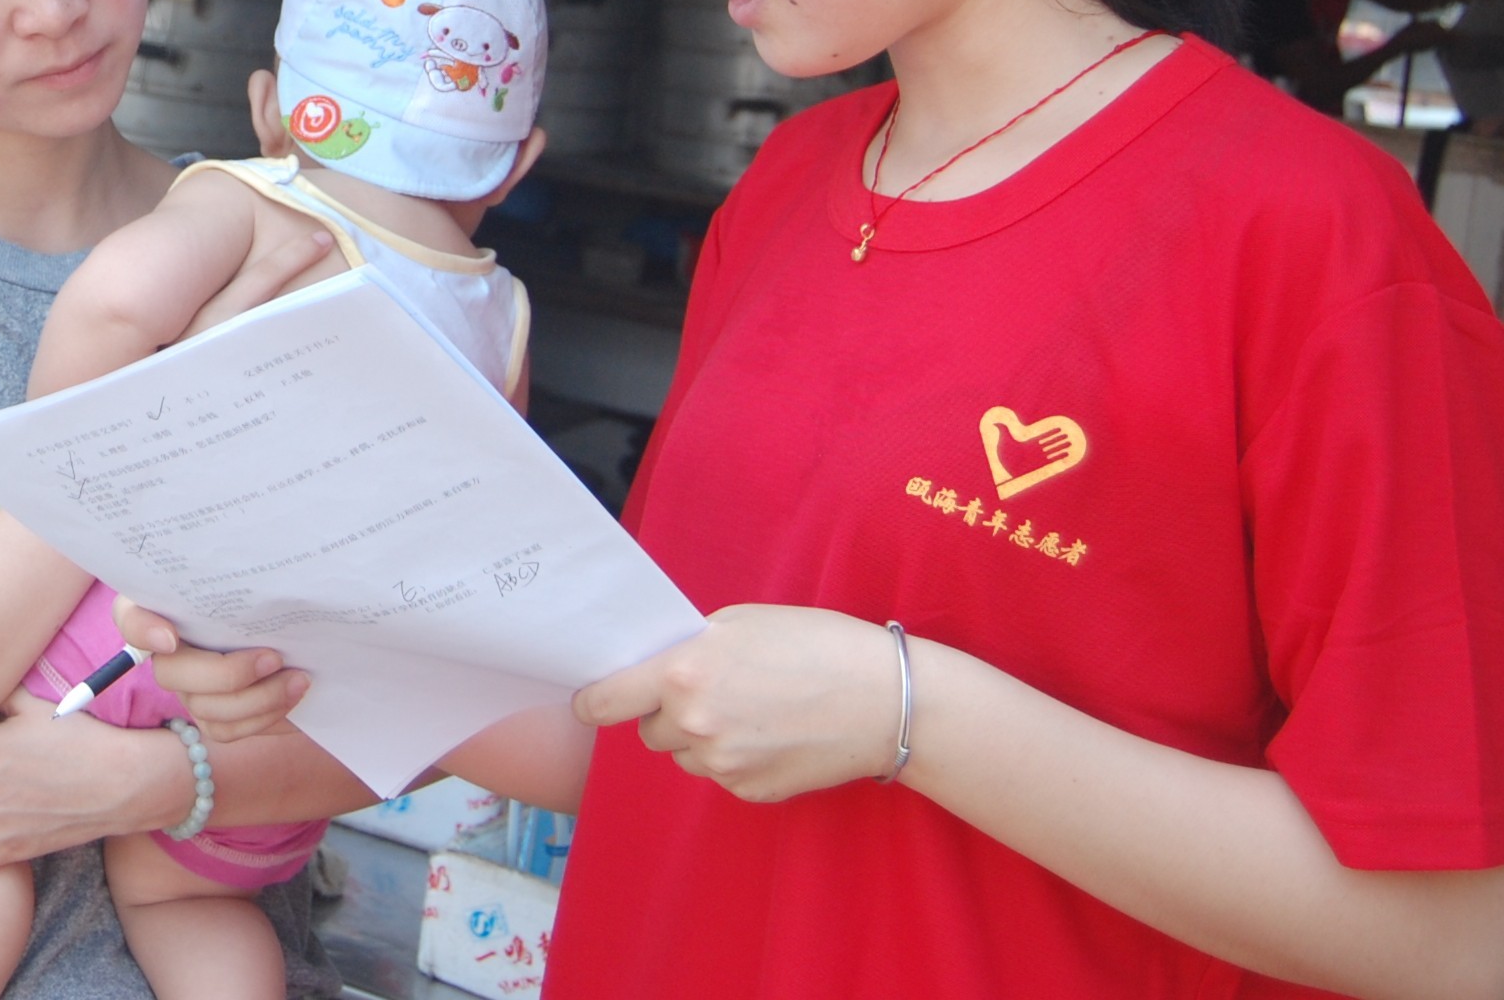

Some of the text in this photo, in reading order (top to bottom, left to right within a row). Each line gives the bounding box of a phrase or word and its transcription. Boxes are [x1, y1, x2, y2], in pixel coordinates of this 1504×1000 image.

[905, 477, 1087, 566] 瓯海青年志愿者
